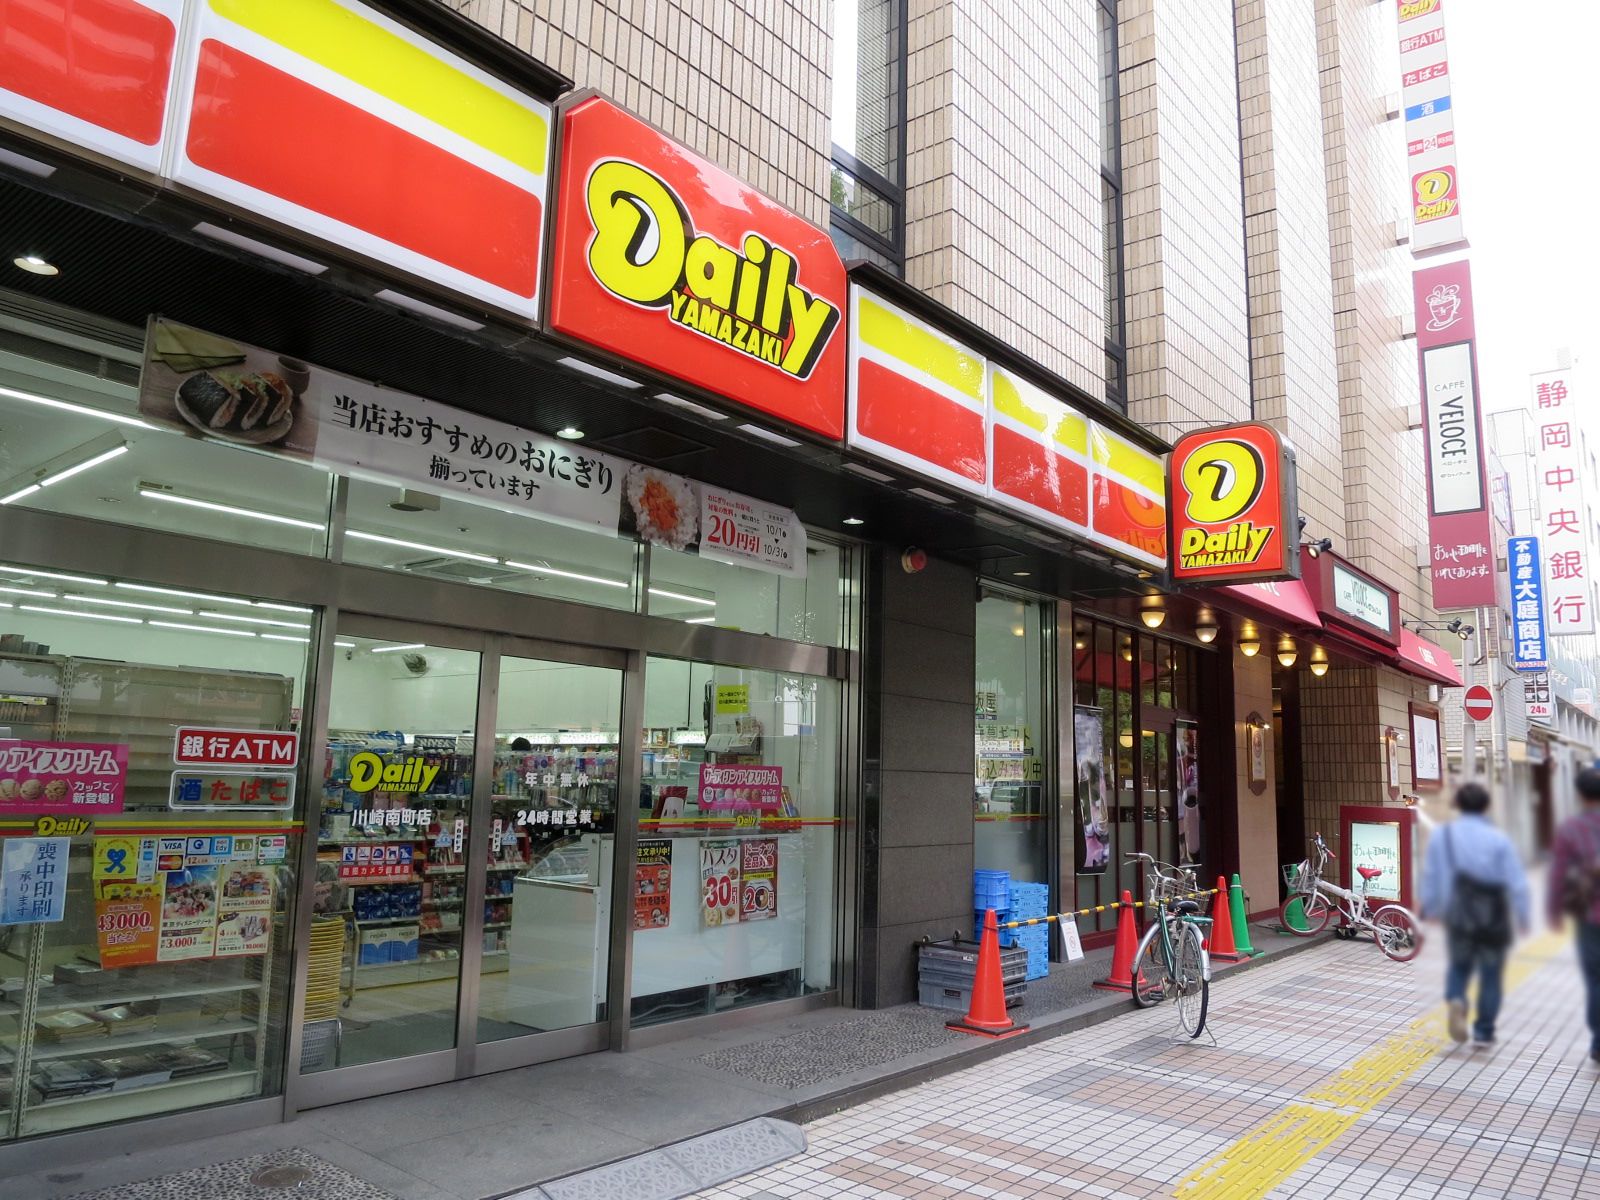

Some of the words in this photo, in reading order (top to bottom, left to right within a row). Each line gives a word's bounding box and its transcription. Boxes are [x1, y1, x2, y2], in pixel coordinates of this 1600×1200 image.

[1404, 66, 1447, 85] たばこ
[1421, 102, 1435, 116] 酒
[1415, 200, 1457, 219] Daily
[586, 157, 840, 380] Daily
[671, 290, 784, 366] YAMAZAKI
[1439, 395, 1467, 459] VELOCE
[332, 394, 614, 495] 当店おすすめのおにぎり
[430, 454, 541, 501] 揃っています
[1536, 379, 1585, 624] 静岡中央銀行
[1181, 522, 1274, 563] Daily
[1181, 551, 1247, 568] YAMAZAKI
[182, 735, 293, 761] 銀行ATM
[350, 751, 441, 793] Daily
[525, 771, 589, 788] 年中無休
[178, 778, 203, 801] 酒
[210, 779, 289, 802] たばこ
[377, 782, 419, 793] YAMAZAKI
[37, 816, 90, 836] Daily
[352, 808, 432, 826] 川崎南町店
[517, 809, 592, 826] 24時間営業
[164, 842, 182, 850] VISA
[703, 848, 738, 867] パスタ
[32, 842, 57, 917] 喪中印刷
[16, 871, 32, 917] 承ります
[706, 875, 733, 910] 30
